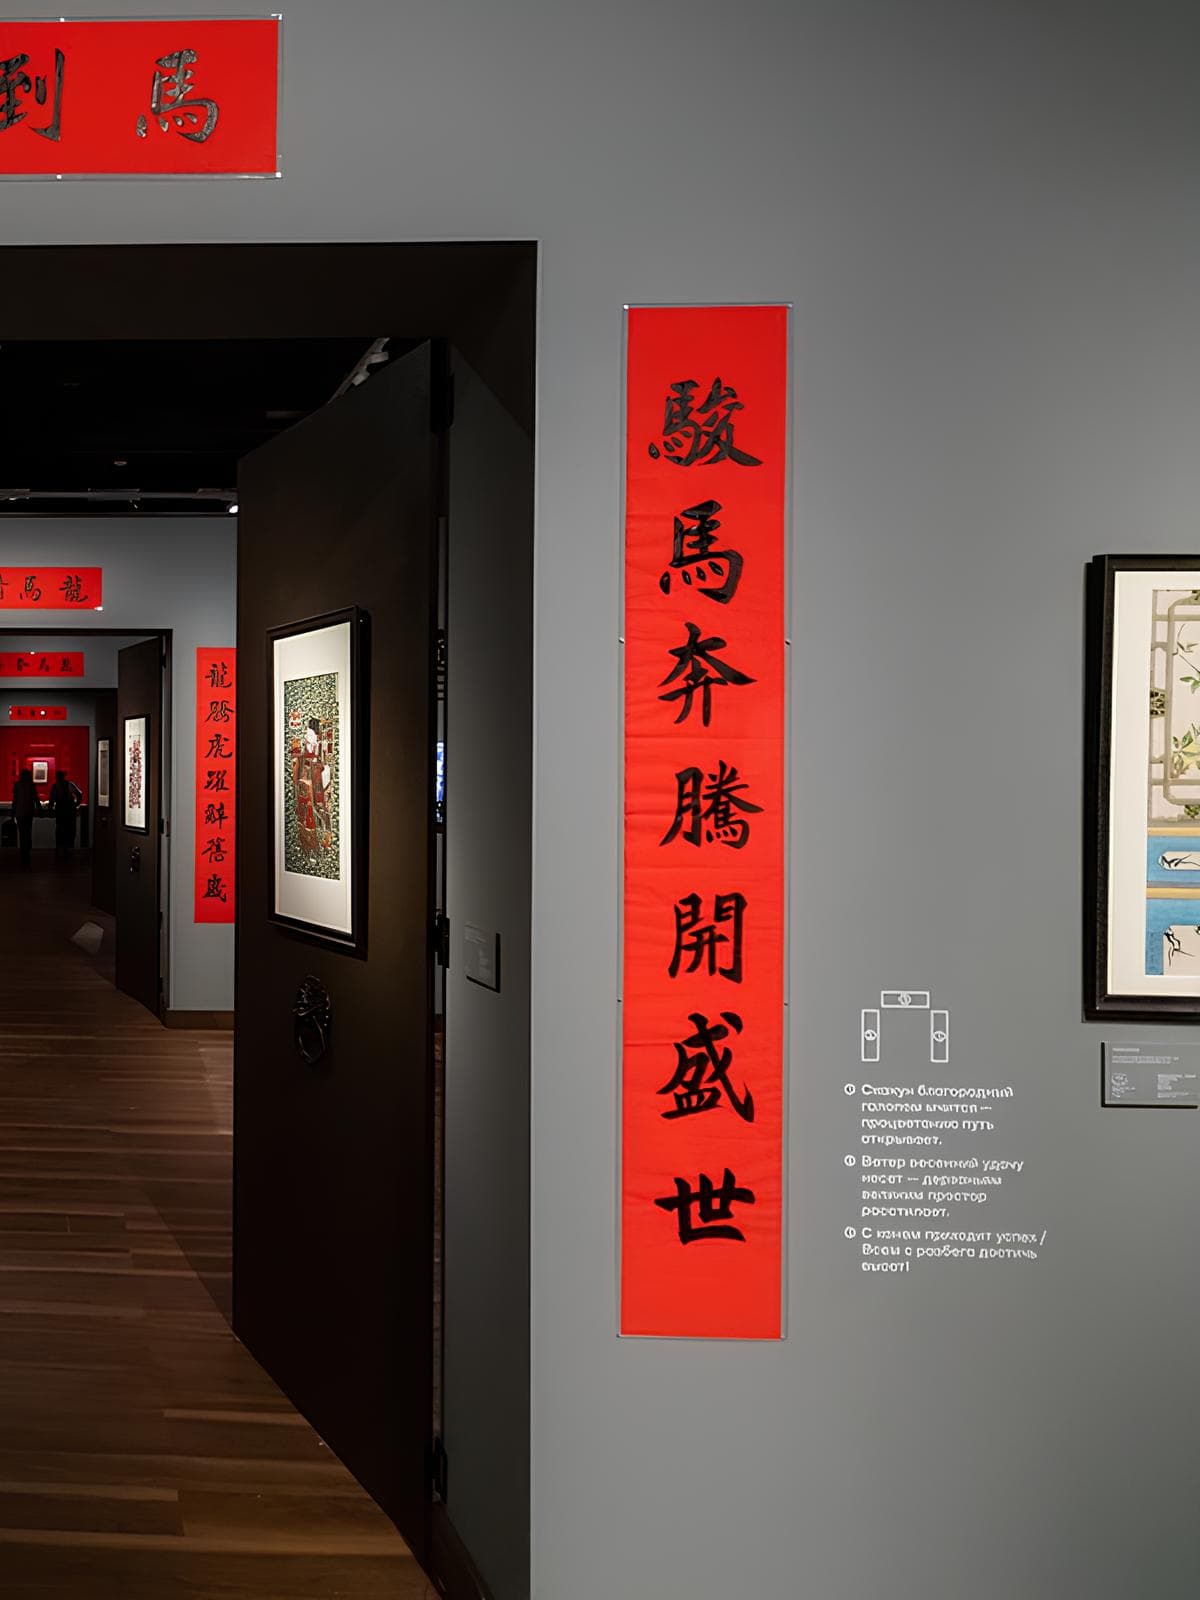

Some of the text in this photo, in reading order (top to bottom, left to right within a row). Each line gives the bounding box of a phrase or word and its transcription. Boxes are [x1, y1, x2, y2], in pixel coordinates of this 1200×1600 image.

[648, 376, 764, 1246] 駿馬奔騰開盛世
